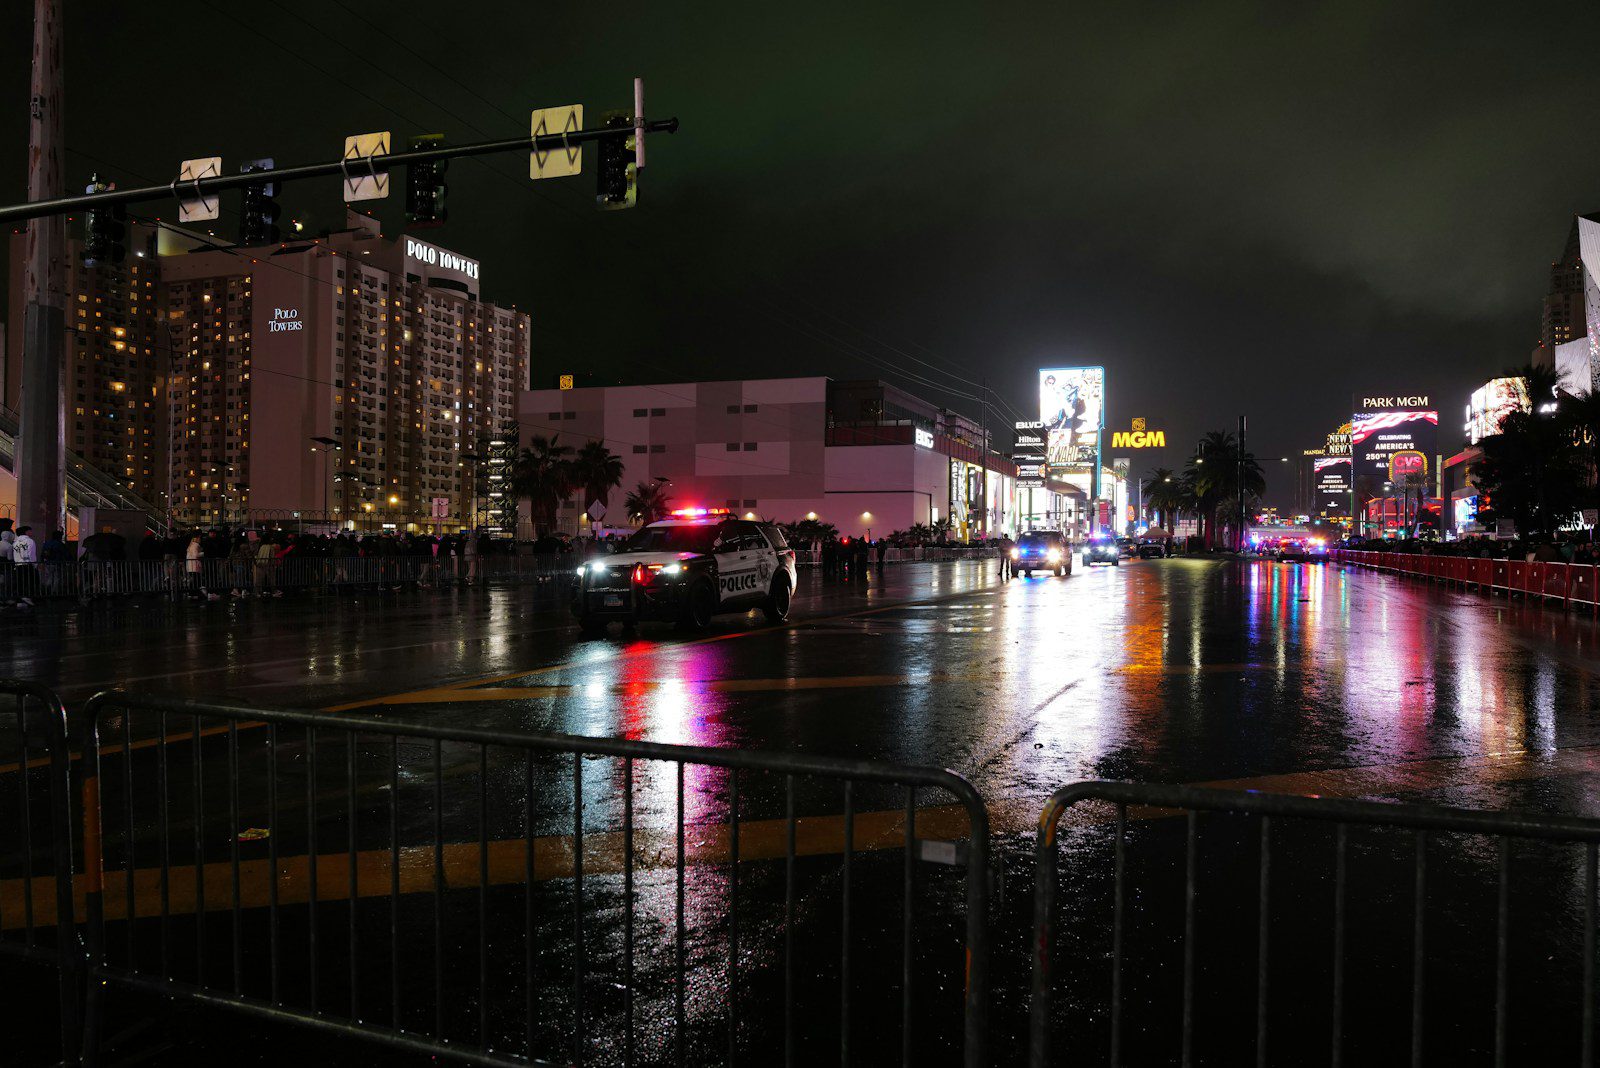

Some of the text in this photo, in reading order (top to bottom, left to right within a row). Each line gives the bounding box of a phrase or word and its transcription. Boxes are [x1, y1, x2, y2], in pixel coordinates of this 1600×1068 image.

[407, 239, 479, 280] POLO TOWERS
[274, 308, 298, 320] POLO
[268, 320, 303, 333] TOWERS
[1363, 396, 1429, 408] PARK MGM
[1015, 421, 1043, 429] BLVD
[1018, 435, 1041, 443] Hilton
[1111, 431, 1166, 448] MGM
[1329, 434, 1347, 443] NEW
[1329, 444, 1347, 454] NEW
[1394, 456, 1423, 467] CVS
[720, 574, 757, 593] POLICE
